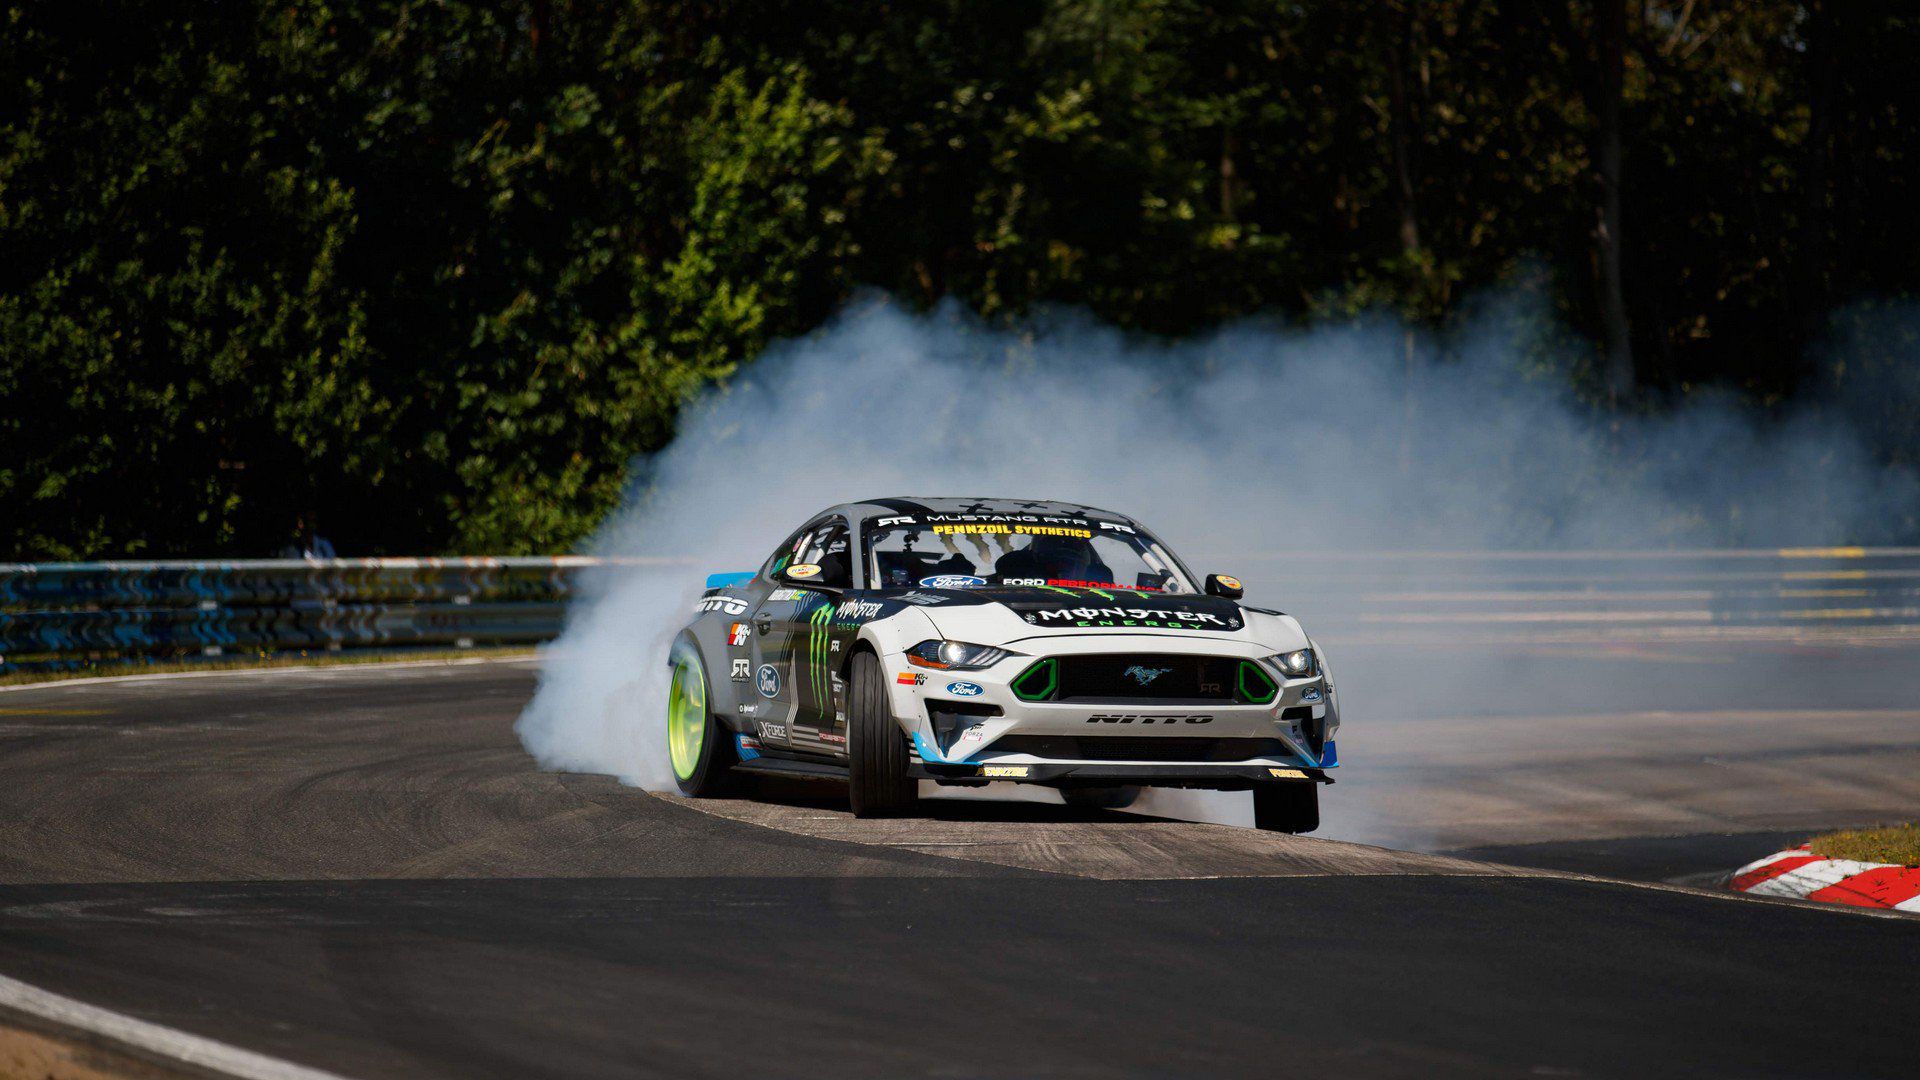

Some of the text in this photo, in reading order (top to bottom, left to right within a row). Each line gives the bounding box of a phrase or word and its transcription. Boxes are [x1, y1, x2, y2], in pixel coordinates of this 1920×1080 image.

[1043, 517, 1088, 526] RTR
[933, 524, 1091, 540] PENNZOIL SYNTHETICS
[1003, 578, 1045, 586] FORD
[696, 596, 748, 615] ITTO
[1038, 607, 1226, 626] MONSTER
[1077, 620, 1202, 630] ENERGY
[951, 683, 978, 696] Ford
[1086, 714, 1214, 725] NITTO
